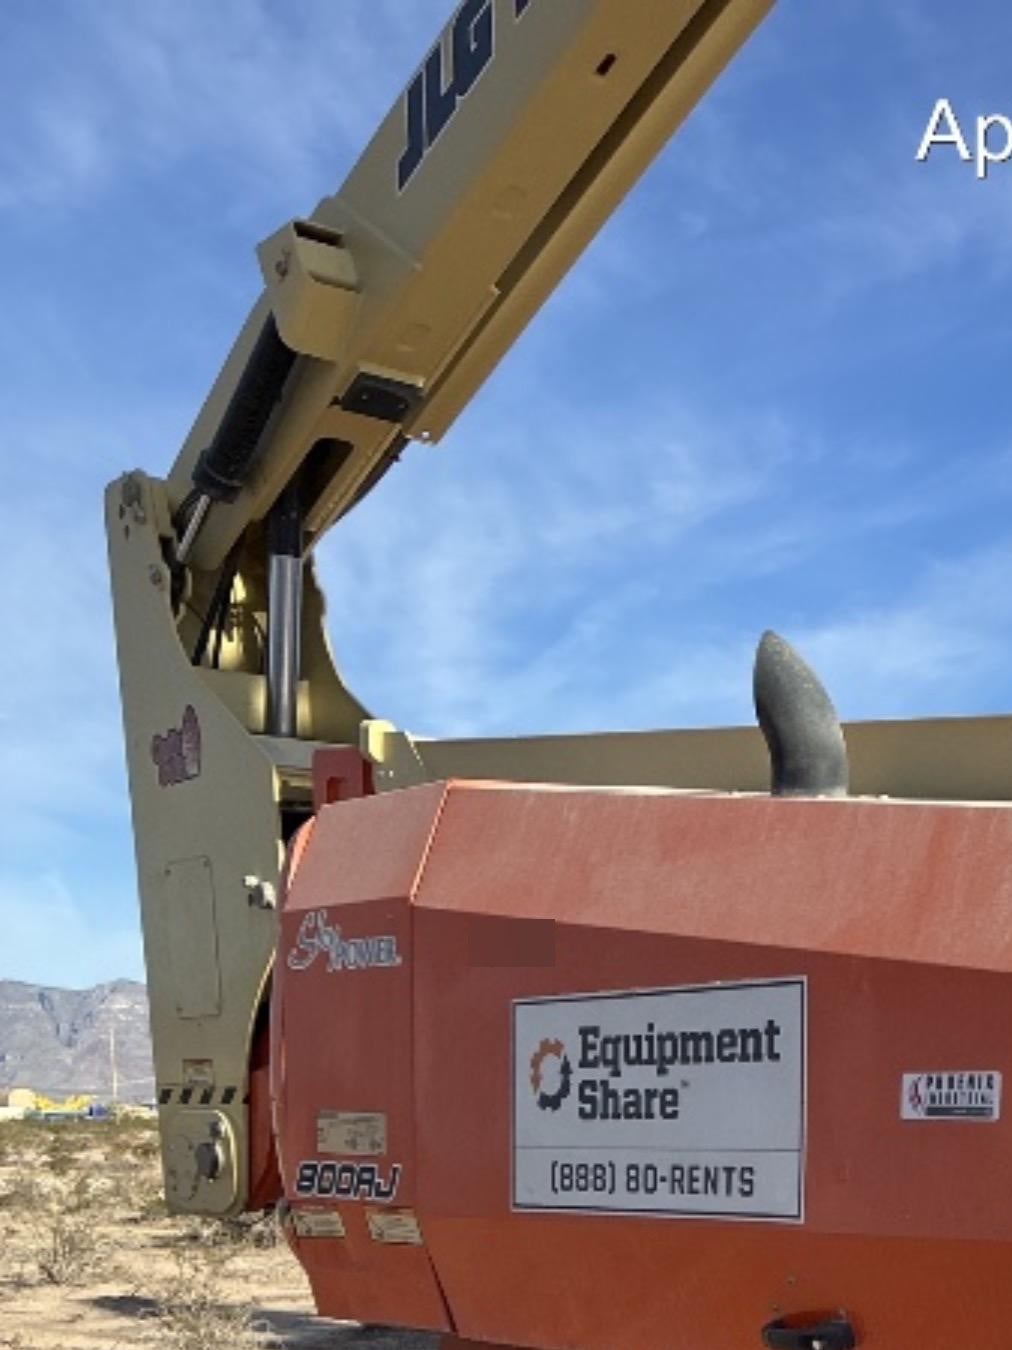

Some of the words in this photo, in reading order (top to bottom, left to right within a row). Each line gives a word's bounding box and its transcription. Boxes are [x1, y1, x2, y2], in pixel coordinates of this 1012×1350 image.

[578, 1019, 781, 1078] Equipment
[578, 1080, 679, 1121] Share
[296, 1161, 401, 1201] 800AJ
[551, 1160, 616, 1194] (888)
[625, 1163, 755, 1197] 80-RENTS
